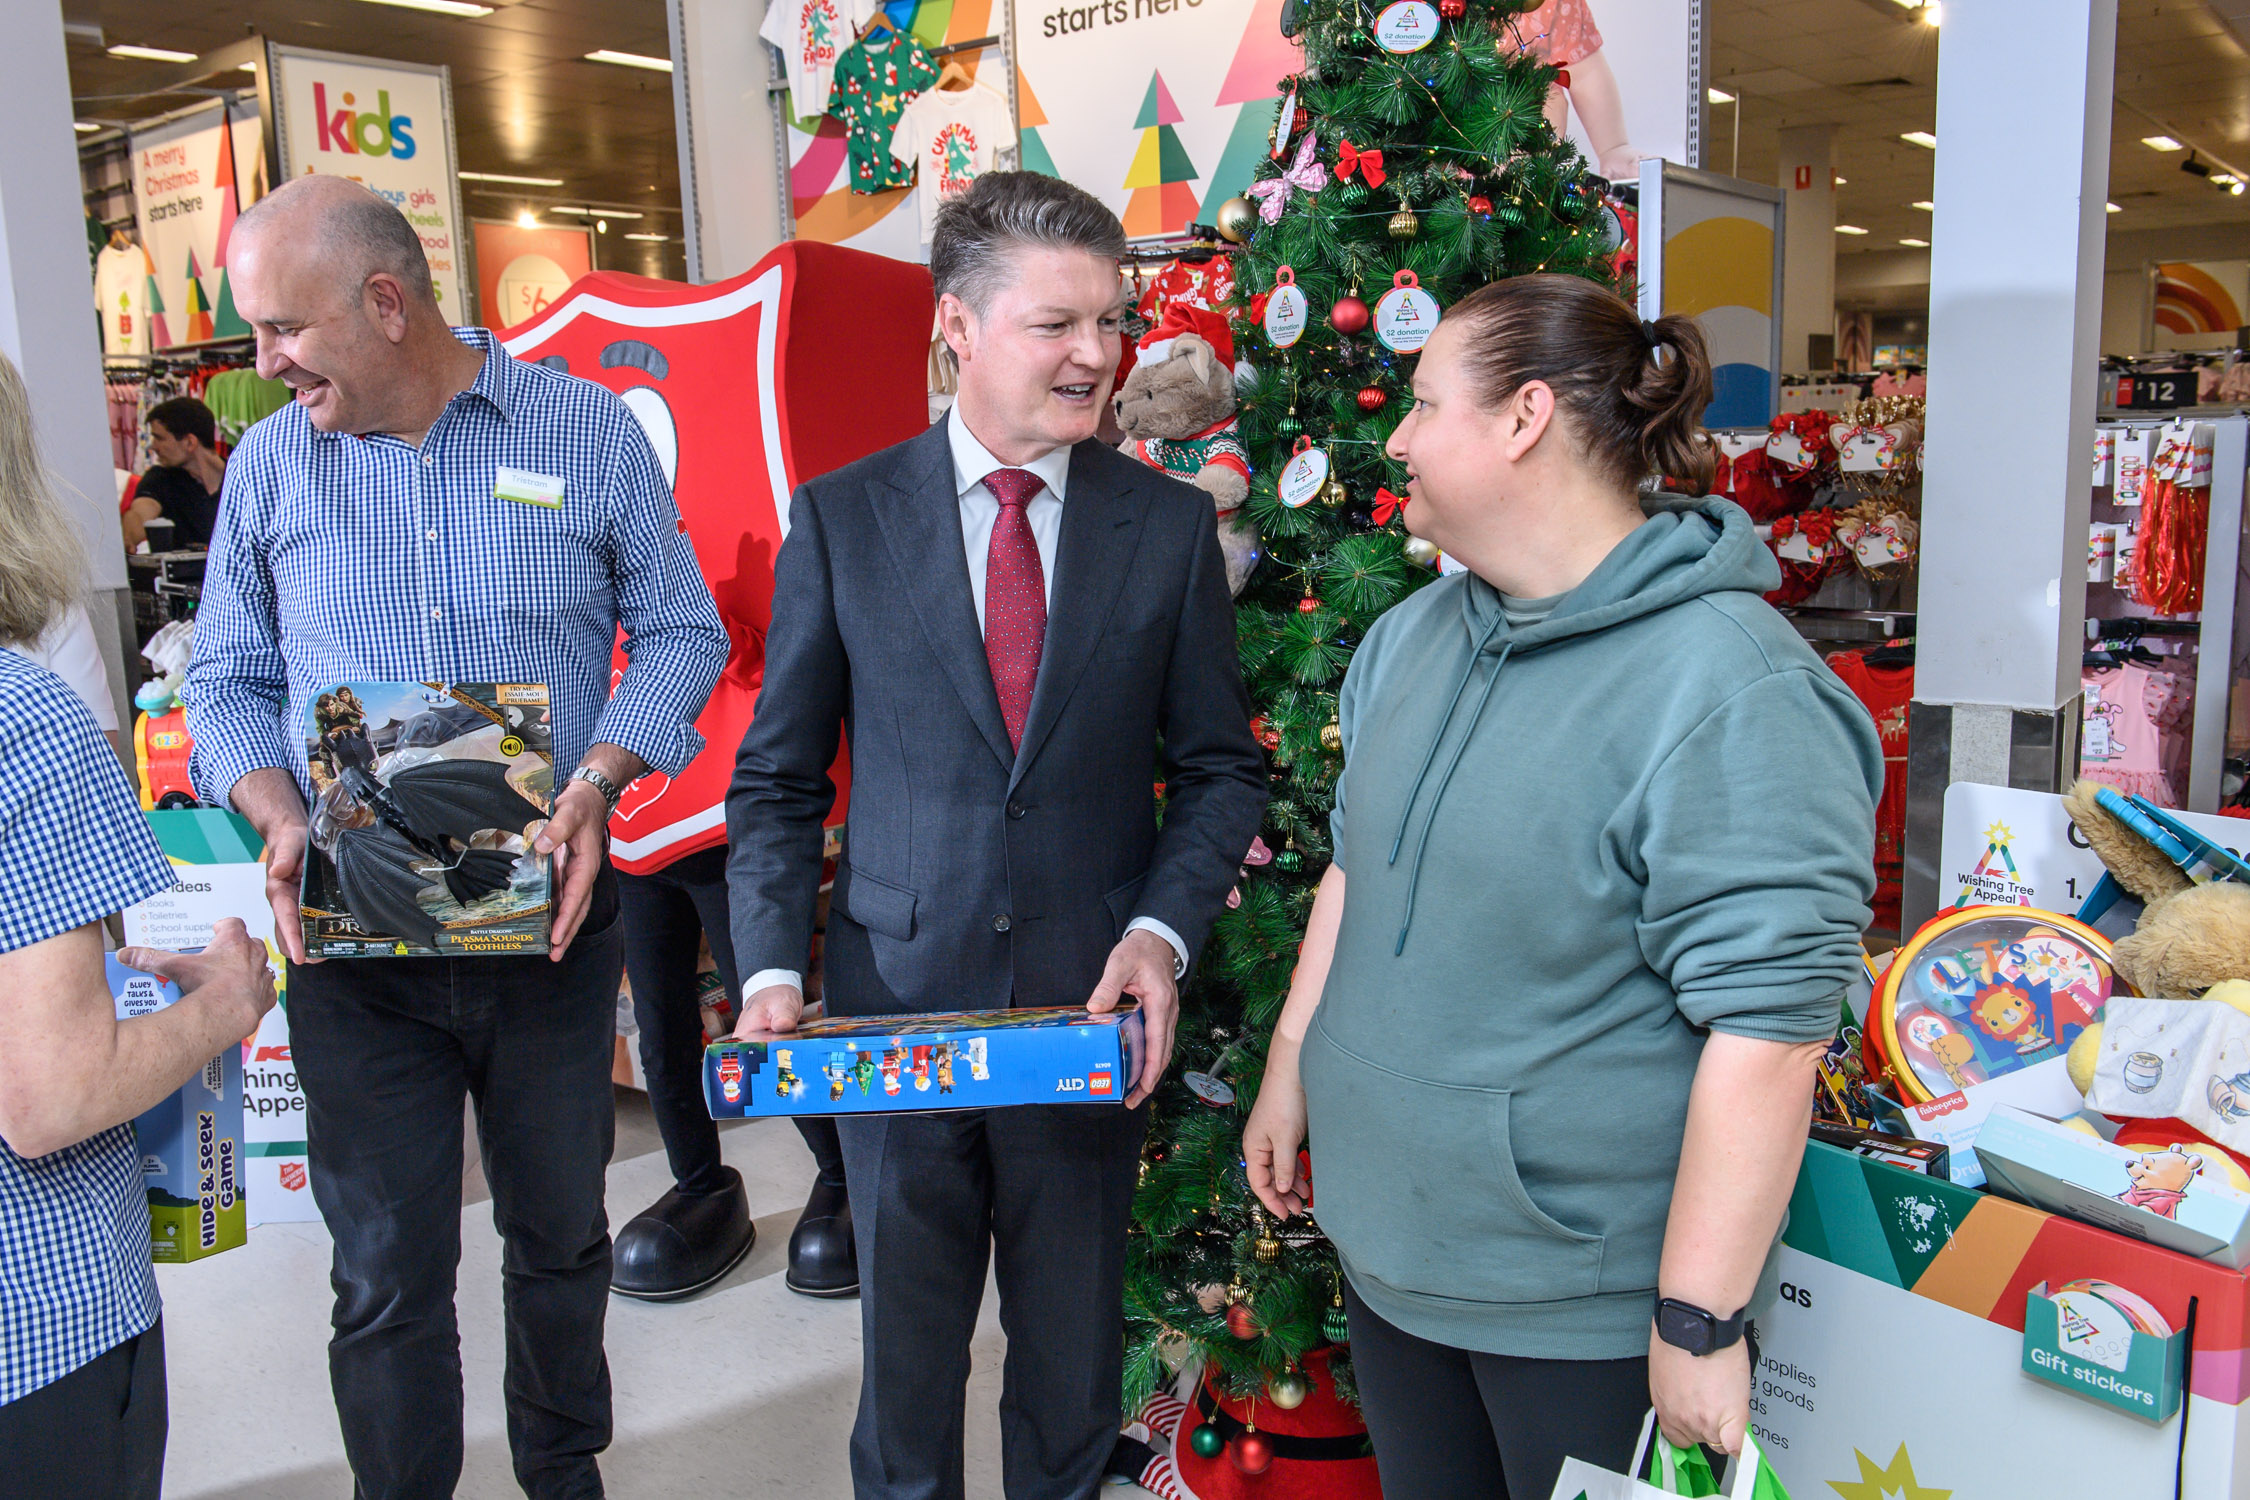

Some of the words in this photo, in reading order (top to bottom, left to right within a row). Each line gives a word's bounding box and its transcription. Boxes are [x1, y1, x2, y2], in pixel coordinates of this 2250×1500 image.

[1043, 0, 1127, 37] starts
[313, 81, 416, 160] kids
[144, 150, 151, 170] A
[153, 145, 185, 168] merry
[146, 170, 199, 196] Christmas
[409, 189, 436, 208] girls
[149, 202, 177, 222] starts
[177, 196, 202, 214] here
[409, 211, 444, 227] heels
[419, 234, 449, 249] hool
[512, 475, 548, 488] Tristram
[1958, 873, 2004, 892] Wishing
[2008, 882, 2034, 896] Tree
[2066, 877, 2082, 900] 1.
[146, 899, 175, 908] Books
[1974, 888, 2016, 904] Appeal
[148, 911, 188, 920] Toiletries
[149, 924, 181, 932] School
[184, 923, 214, 932] supplie
[325, 920, 367, 935] DR
[151, 937, 190, 946] Sporting
[451, 935, 490, 943] PLASMA
[491, 934, 533, 942] SOUNDS
[463, 943, 521, 951] TOOTHLESS
[243, 1068, 299, 1092] hing
[1055, 1077, 1086, 1092] CITY
[1091, 1079, 1110, 1088] LEGO
[243, 1093, 305, 1118] Appe
[1950, 1163, 1982, 1181] Dru
[201, 1172, 214, 1192] &
[1780, 1281, 1812, 1308] as
[1759, 1355, 1816, 1388] upplies
[2031, 1348, 2068, 1375] Gift
[2073, 1366, 2154, 1405] stickers
[1762, 1380, 1815, 1412] goods
[1749, 1398, 1767, 1415] ds
[1751, 1423, 1789, 1449] ones
